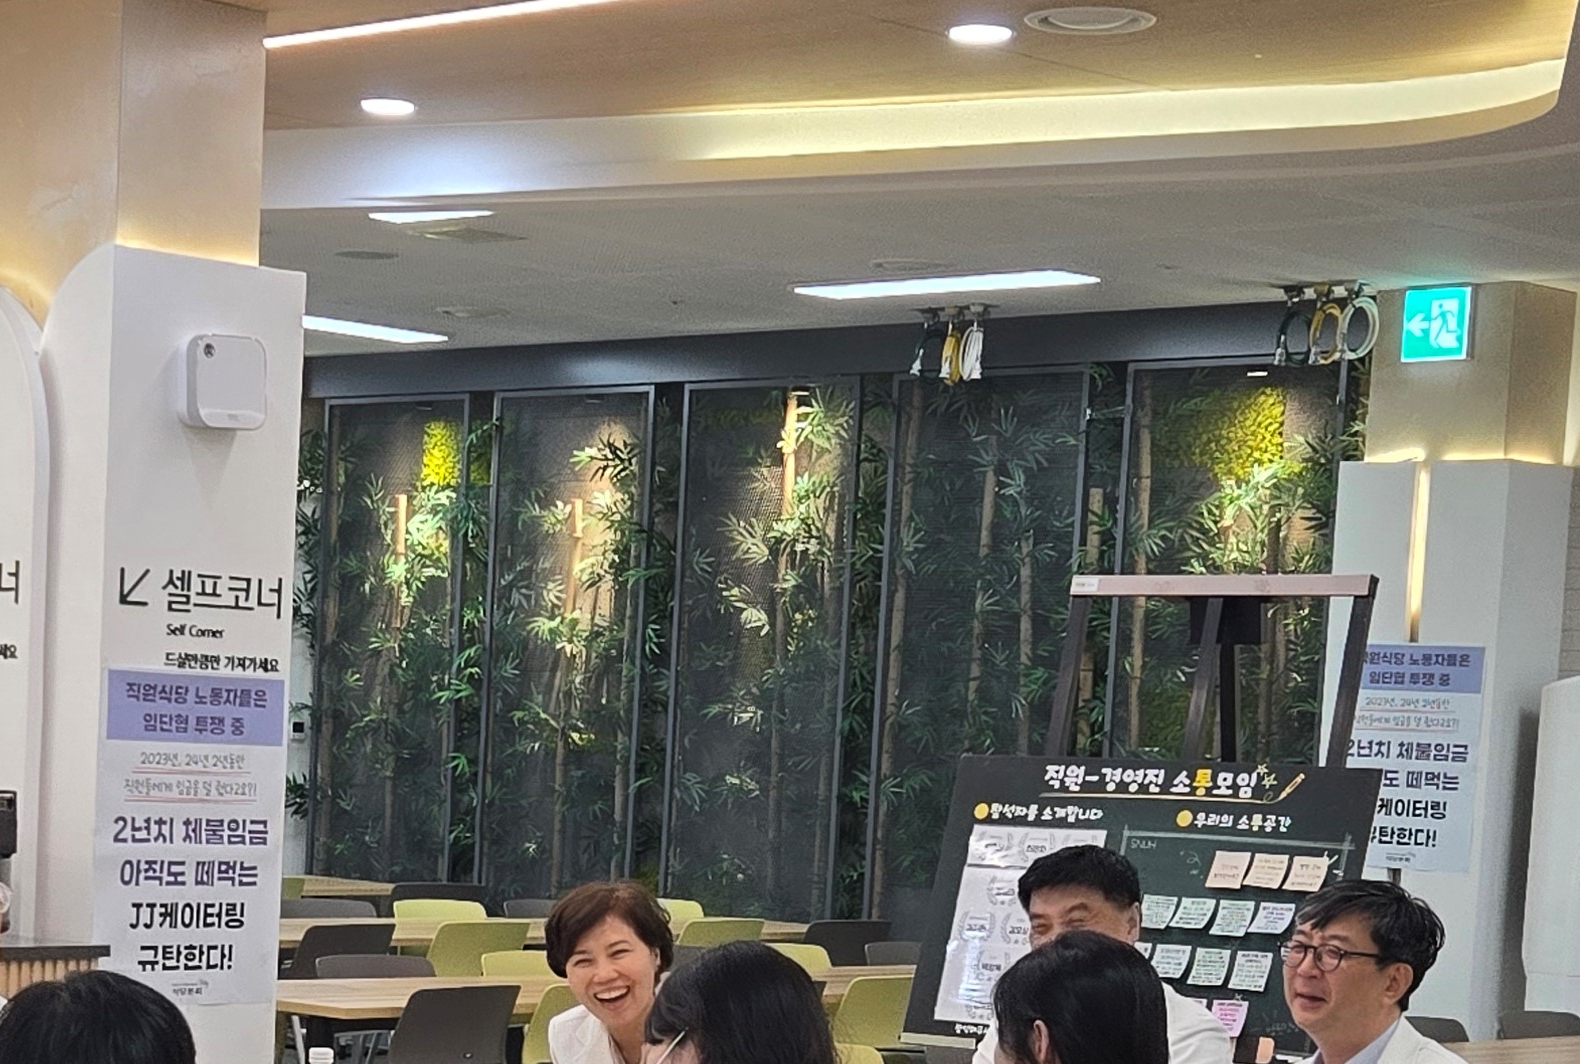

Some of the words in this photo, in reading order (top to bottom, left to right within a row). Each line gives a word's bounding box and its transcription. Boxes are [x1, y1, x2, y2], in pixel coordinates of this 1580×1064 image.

[162, 568, 283, 619] 셀프코너
[166, 623, 187, 638] Self
[189, 624, 225, 639] Corner
[1409, 652, 1471, 668] 노동자들은
[1409, 672, 1435, 686] 투쟁
[125, 682, 189, 706] 직원식당
[194, 685, 267, 709] 노동자들은
[143, 713, 189, 734] 임단협
[194, 715, 225, 735] 투쟁
[230, 716, 245, 736] 중
[1346, 740, 1390, 758] 2년치
[1397, 741, 1468, 763] 체불임금
[1044, 765, 1164, 792] 직원-경영진
[1170, 769, 1257, 798] 소통모임
[1406, 771, 1460, 790] 떼먹는
[1377, 798, 1447, 820] 케이터링
[113, 816, 174, 845] 2년치
[182, 818, 268, 846] 체불임금
[1194, 813, 1234, 829] 우리의
[1236, 815, 1292, 832] 소통공간
[120, 860, 187, 887] 아직도
[194, 860, 258, 887] 떼먹는
[129, 902, 245, 930] JJ케이터링
[137, 944, 233, 971] 규탄한다!
